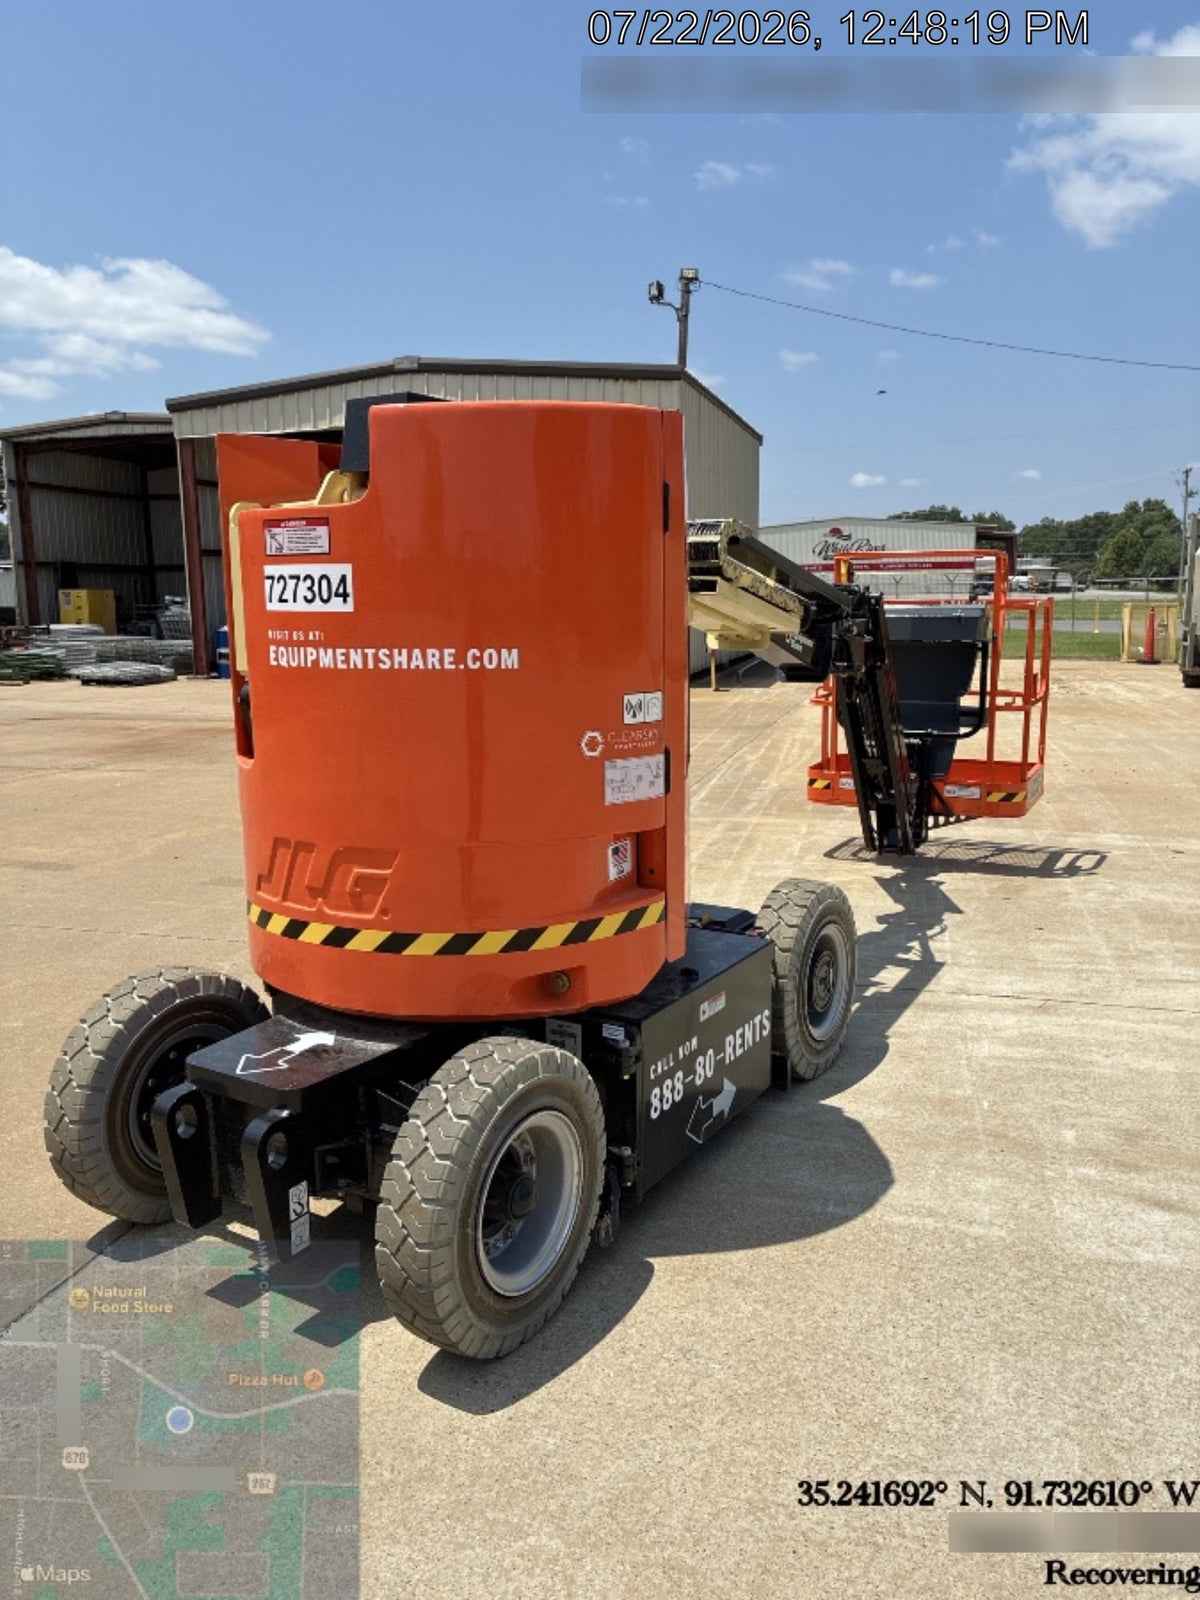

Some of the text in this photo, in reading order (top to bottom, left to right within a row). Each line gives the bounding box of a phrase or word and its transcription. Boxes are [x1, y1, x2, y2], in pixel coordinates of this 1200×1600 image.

[264, 573, 350, 604] 727304
[268, 644, 520, 670] EQUIPMENTSHARE.COM
[255, 836, 400, 919] JLG
[650, 1035, 698, 1081] CALL NOW
[650, 1008, 771, 1121] 888-80-RENTS
